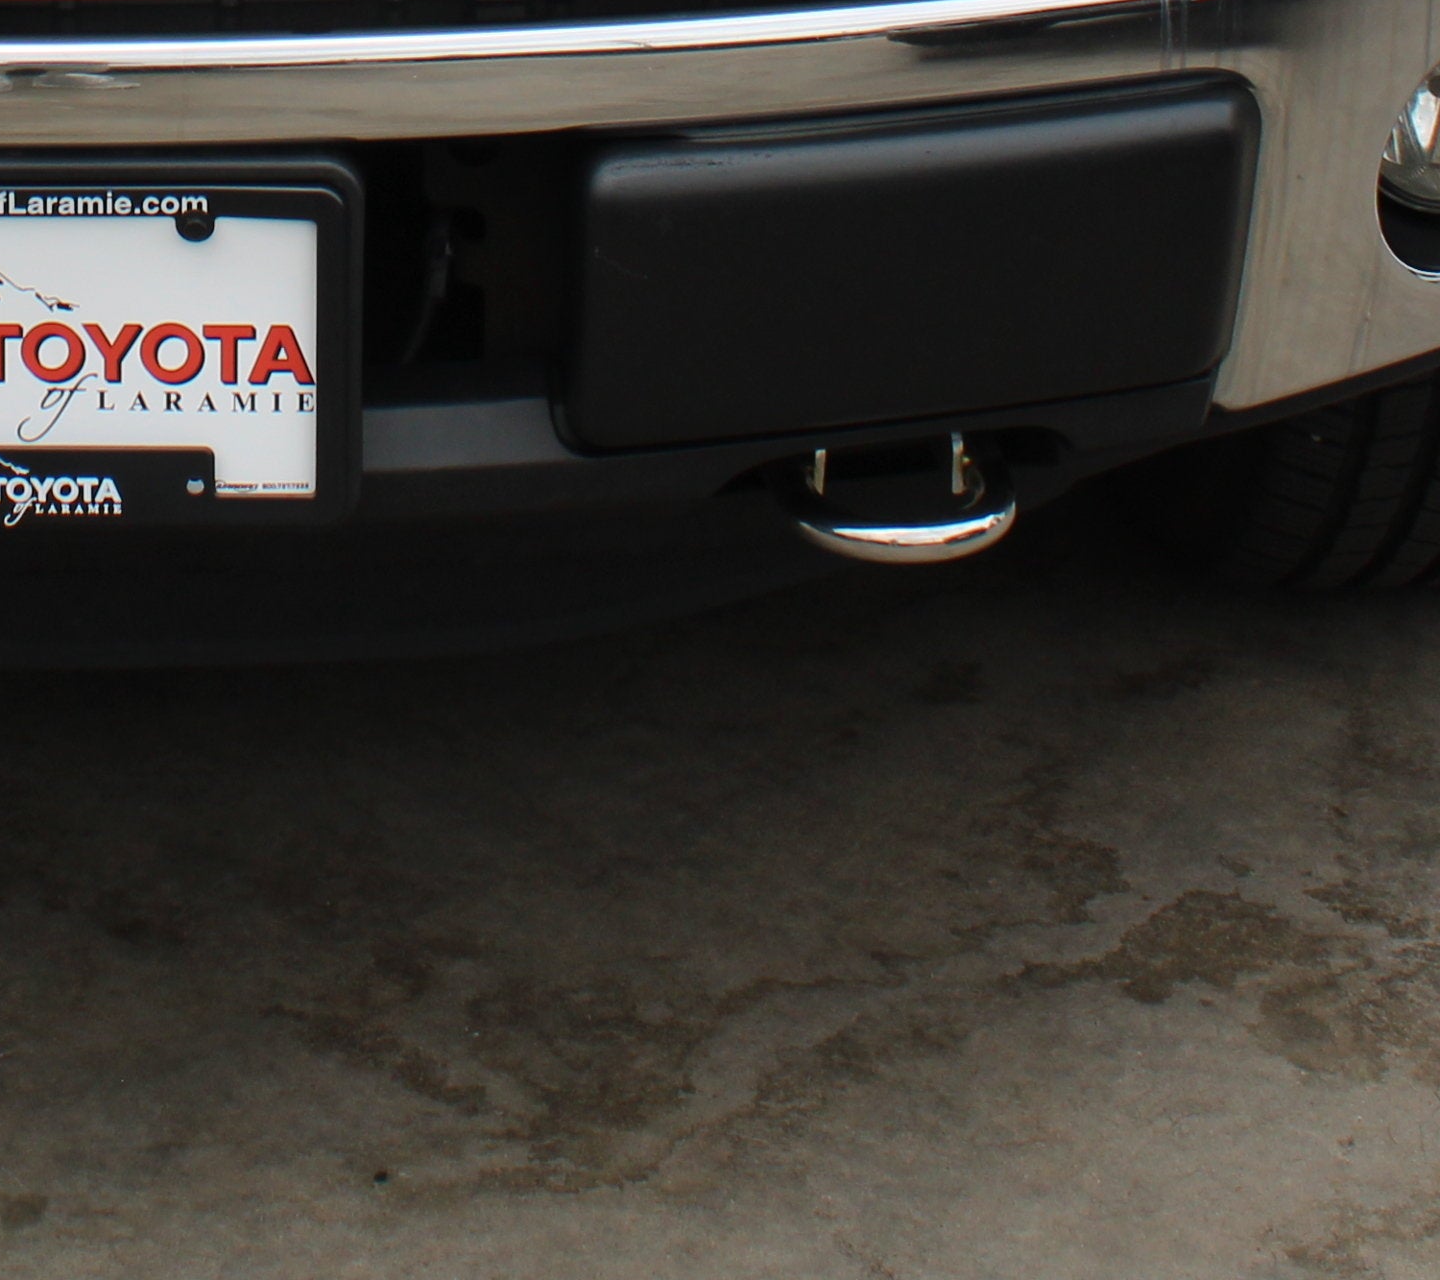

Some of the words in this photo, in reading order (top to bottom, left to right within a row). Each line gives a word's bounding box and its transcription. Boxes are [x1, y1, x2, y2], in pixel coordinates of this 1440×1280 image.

[17, 373, 99, 442] of
[97, 390, 315, 413] LARAMIE
[35, 503, 123, 515] LARAMIE
